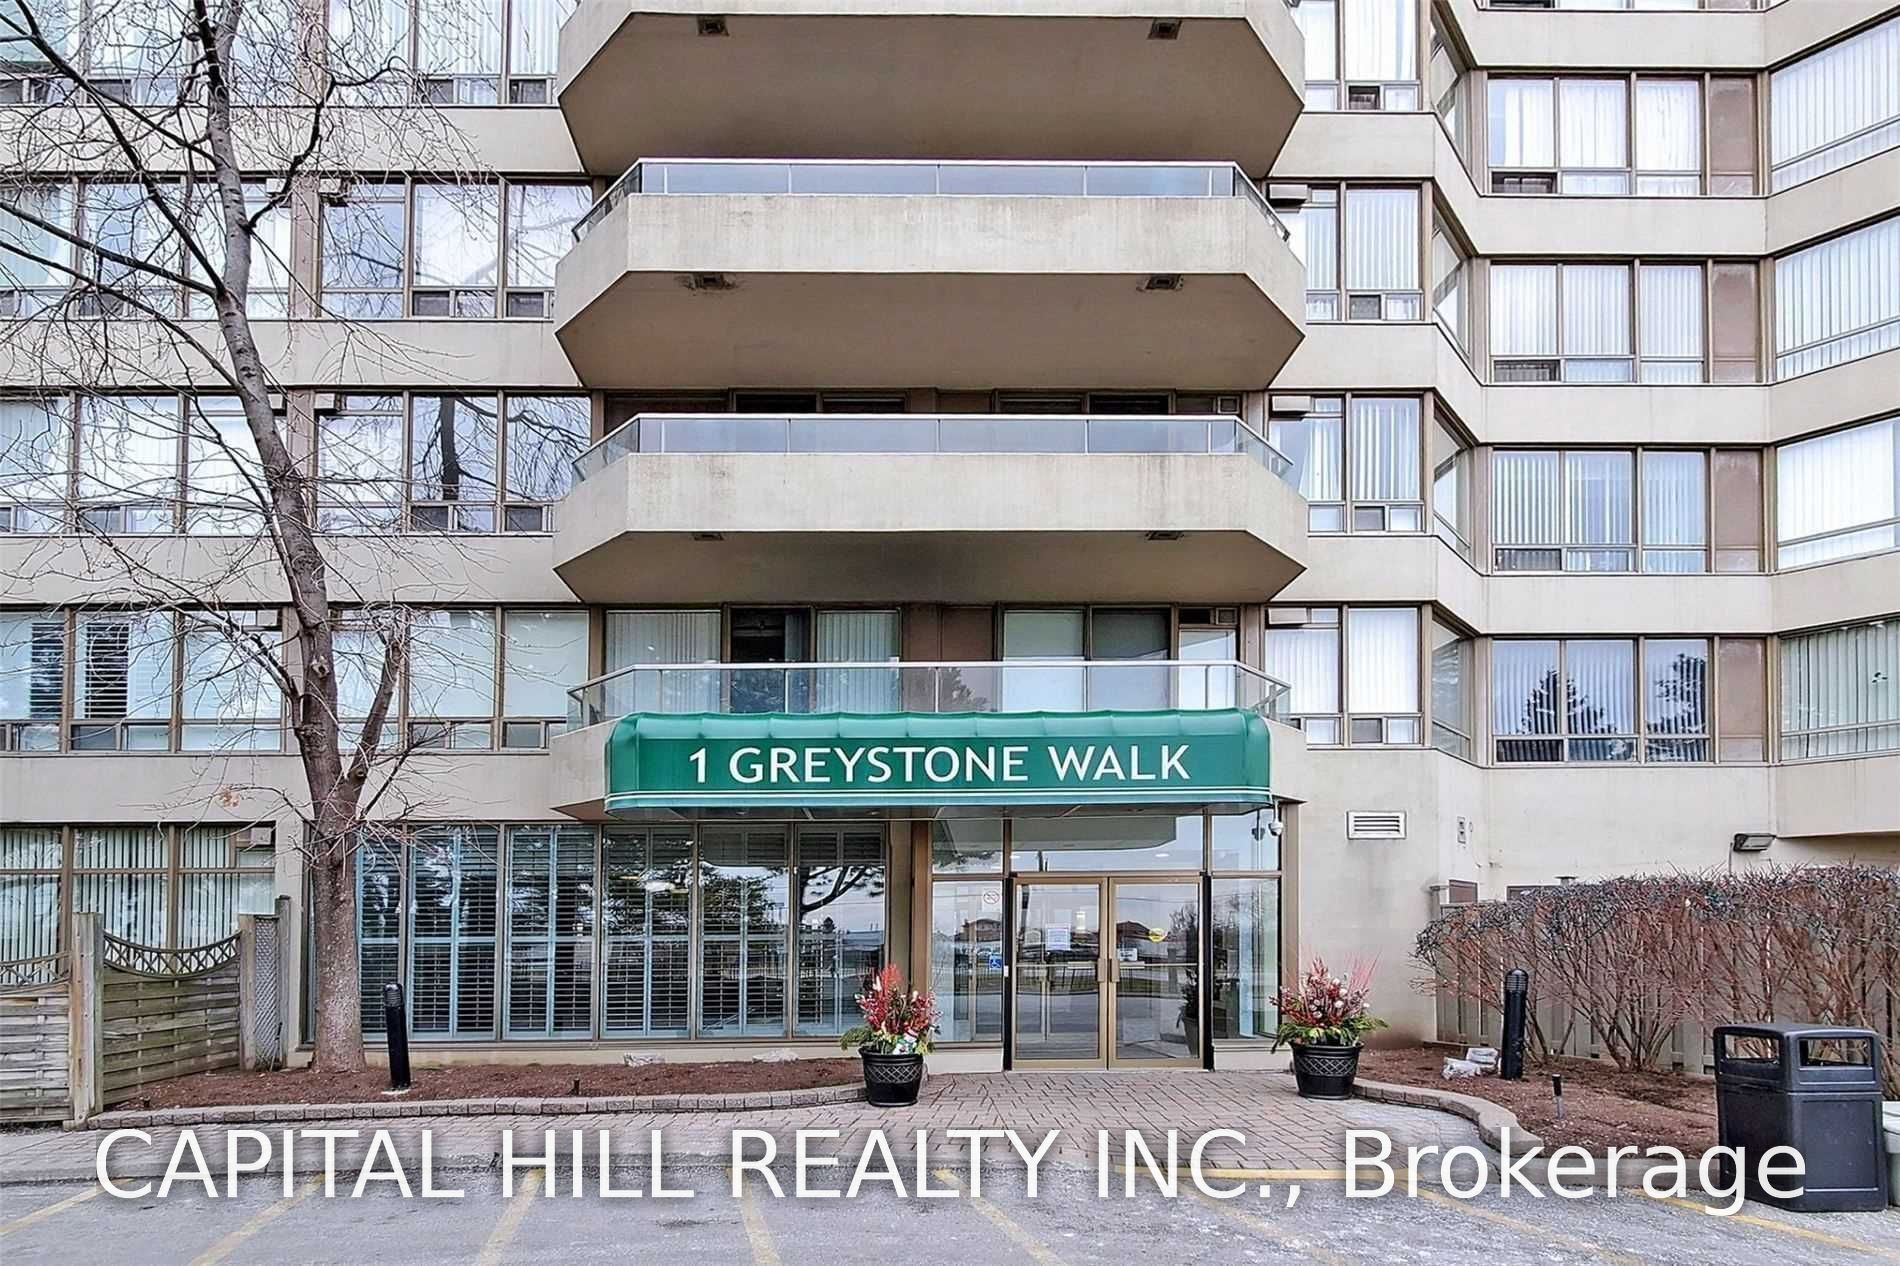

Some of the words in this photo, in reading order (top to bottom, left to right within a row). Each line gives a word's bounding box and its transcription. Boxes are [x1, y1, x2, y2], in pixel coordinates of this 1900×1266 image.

[689, 748, 706, 783] 1
[729, 746, 1028, 783] GREYSTONE
[1047, 745, 1190, 781] WALK
